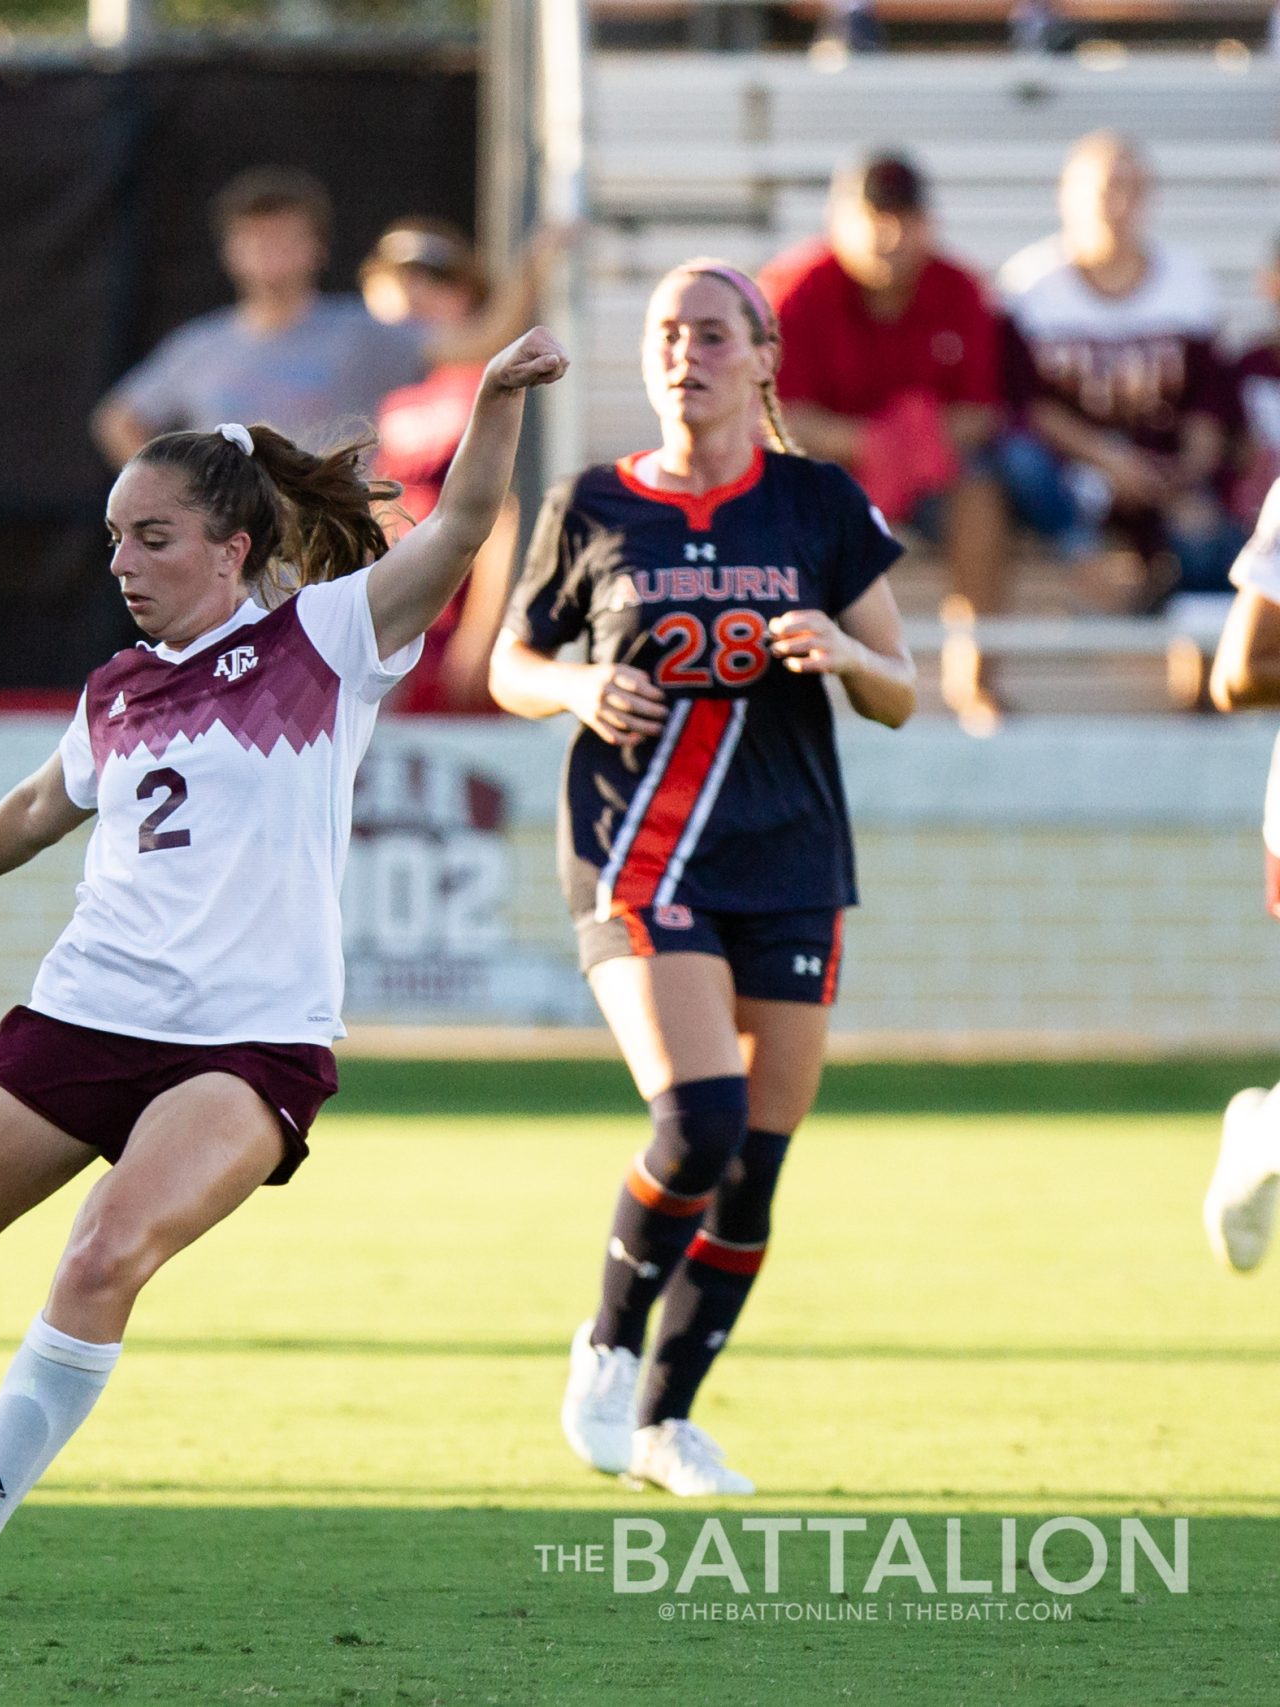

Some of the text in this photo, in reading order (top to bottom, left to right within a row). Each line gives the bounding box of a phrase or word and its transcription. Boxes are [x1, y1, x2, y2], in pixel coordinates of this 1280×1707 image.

[611, 565, 800, 605] AUBURN
[651, 608, 769, 688] 28
[136, 766, 191, 854] 2
